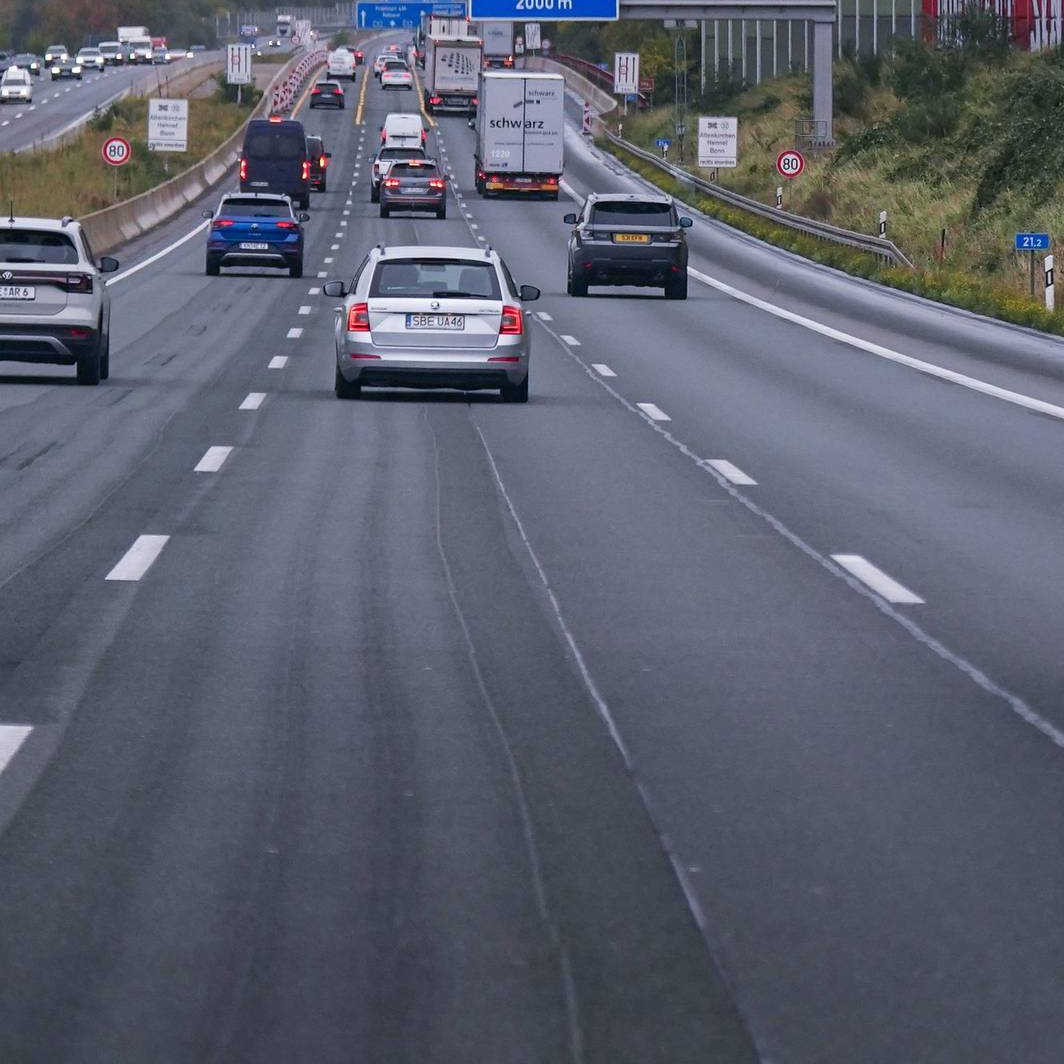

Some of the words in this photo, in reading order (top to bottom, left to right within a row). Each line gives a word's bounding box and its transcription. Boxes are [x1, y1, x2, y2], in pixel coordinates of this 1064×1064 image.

[489, 116, 544, 129] schwarz
[109, 145, 125, 158] 80
[782, 157, 799, 171] 80
[9, 287, 20, 297] AR
[22, 287, 29, 297] 6
[412, 316, 435, 327] SBE
[436, 316, 463, 328] UA46
